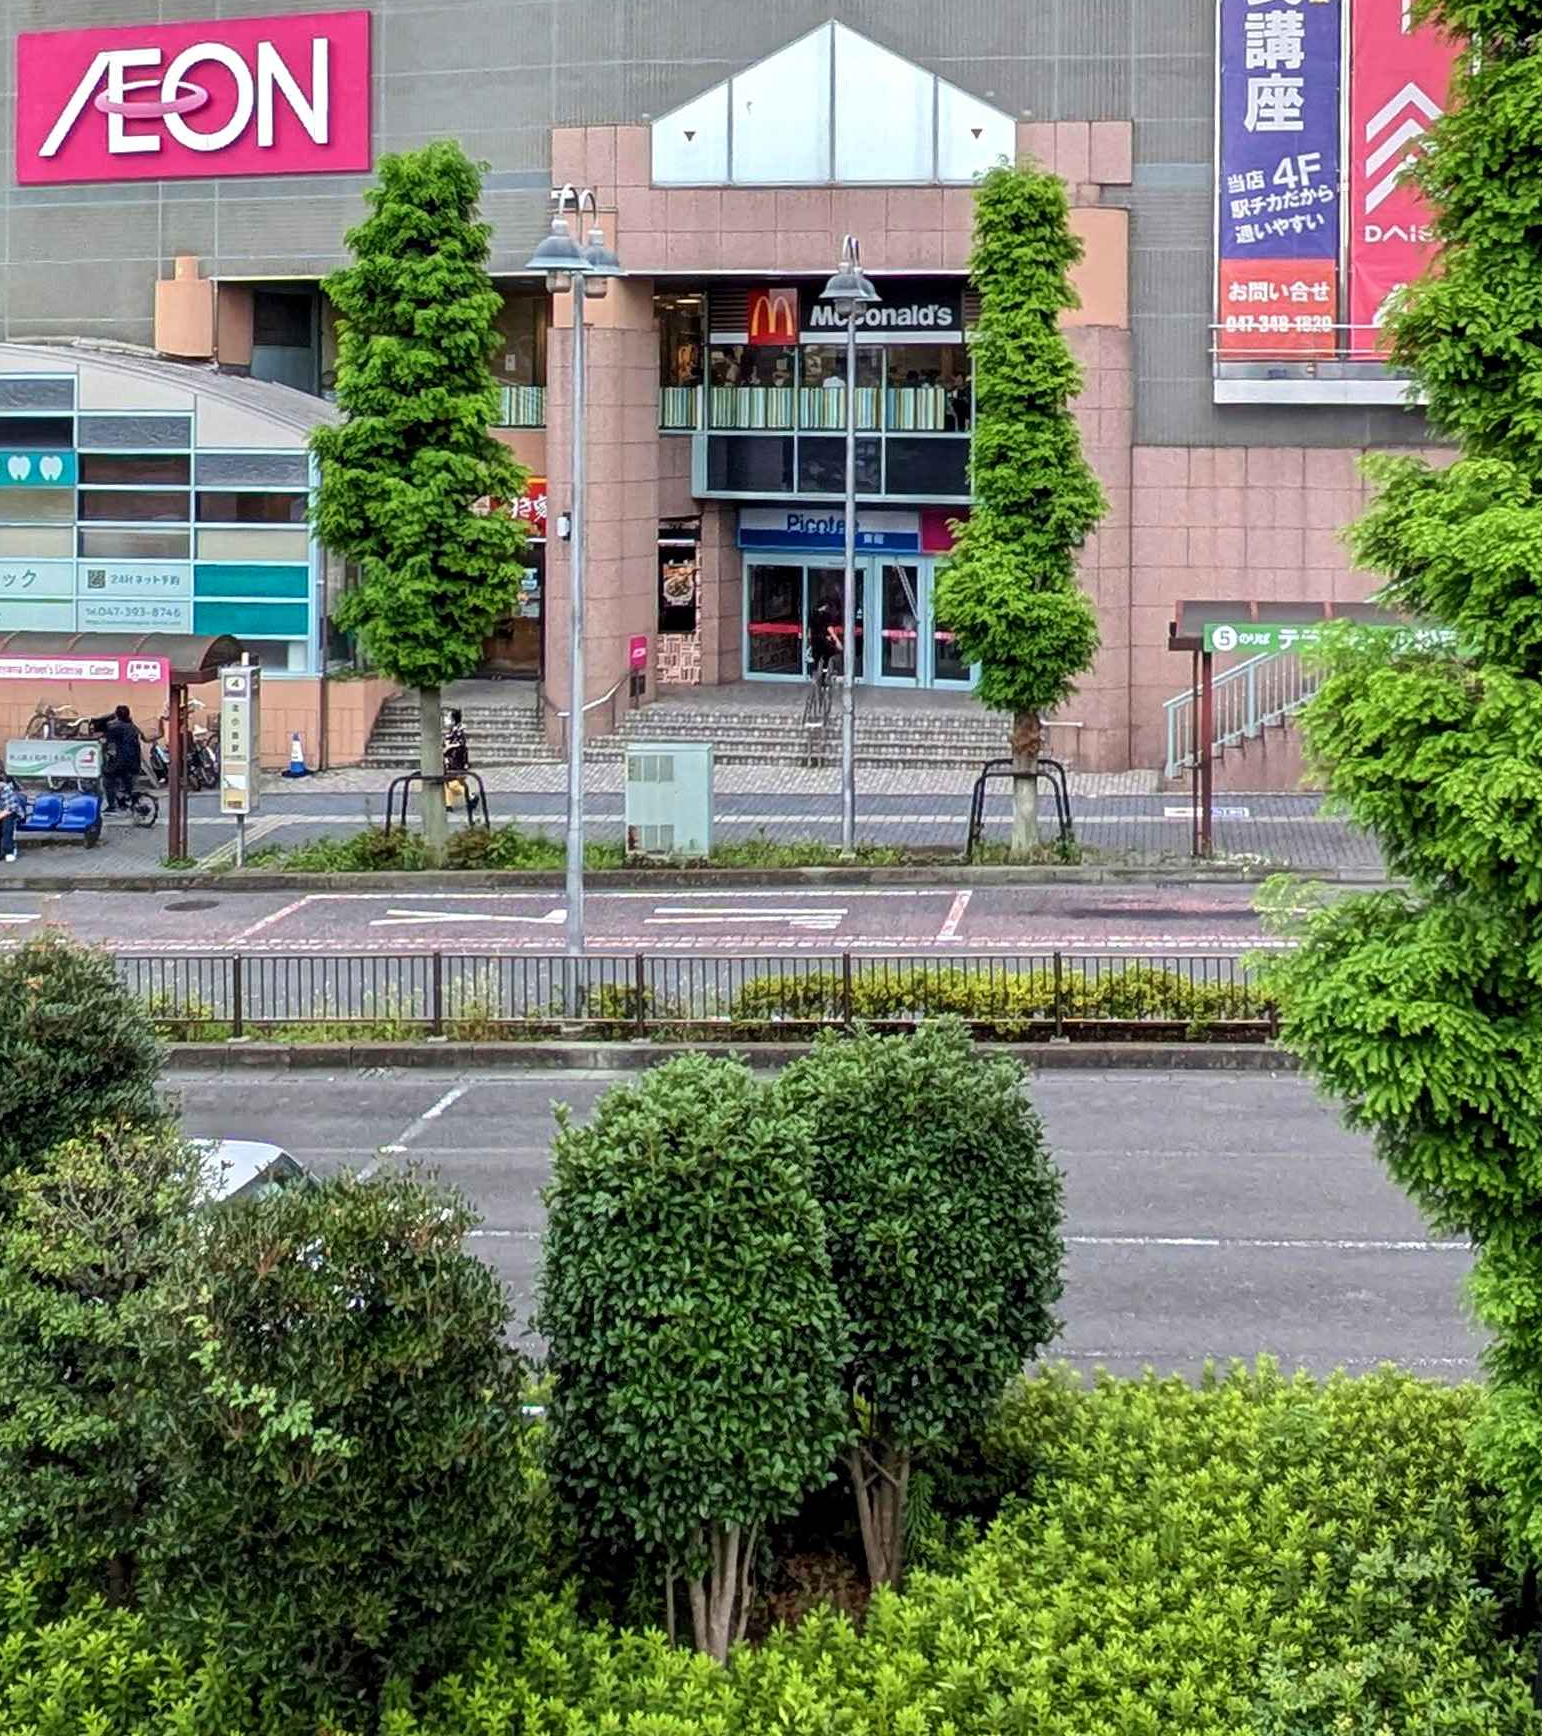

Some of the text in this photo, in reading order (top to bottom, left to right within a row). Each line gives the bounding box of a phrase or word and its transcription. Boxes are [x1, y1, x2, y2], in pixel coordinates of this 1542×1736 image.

[1227, 152, 1322, 194] 当店 4F
[1235, 213, 1325, 244] 通いやすい
[1228, 281, 1331, 302] お問い合せ
[1239, 634, 1270, 645] のりば
